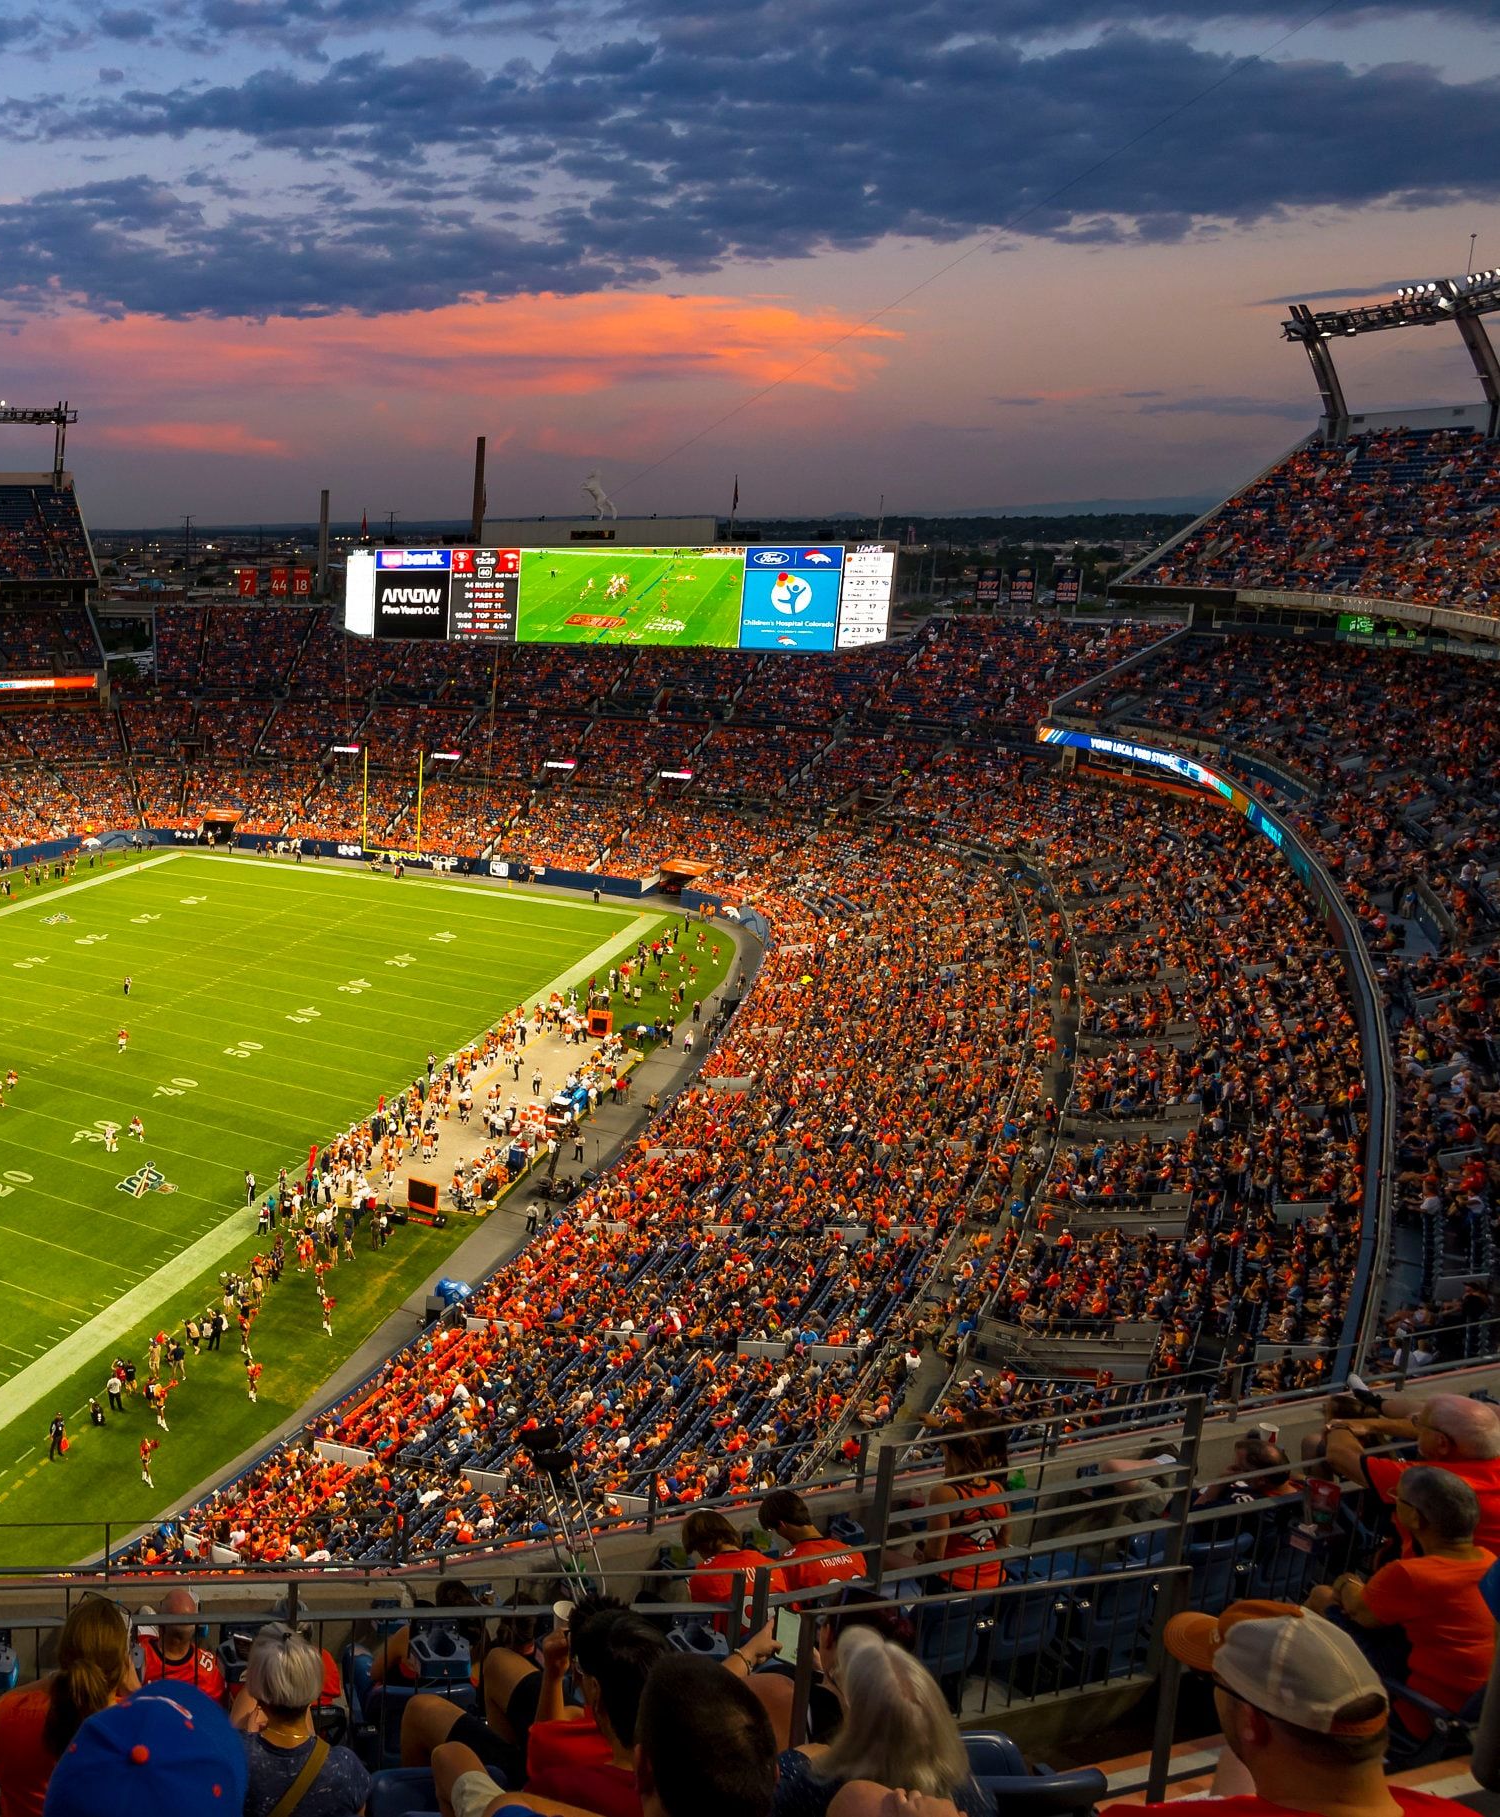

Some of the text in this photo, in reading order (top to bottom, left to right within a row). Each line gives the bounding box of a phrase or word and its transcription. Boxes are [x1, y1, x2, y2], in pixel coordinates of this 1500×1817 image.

[244, 579, 252, 591] 7
[272, 579, 287, 591] 44
[296, 579, 308, 591] 18
[978, 580, 999, 589] 1997
[1011, 581, 1033, 590] 1998
[382, 588, 442, 603] ARROW
[382, 606, 440, 615] Five Years Out
[743, 619, 835, 630] Children's Hospital Colorado
[1091, 738, 1113, 751] YOUR
[1113, 742, 1133, 757] LOCAL
[1133, 747, 1150, 761] FORD
[429, 932, 457, 943] 10
[384, 954, 417, 968] 20
[337, 979, 372, 994] 30
[285, 1007, 322, 1024] 40
[223, 1041, 264, 1058] 50
[156, 1078, 199, 1096] 40
[74, 1120, 122, 1143] 30
